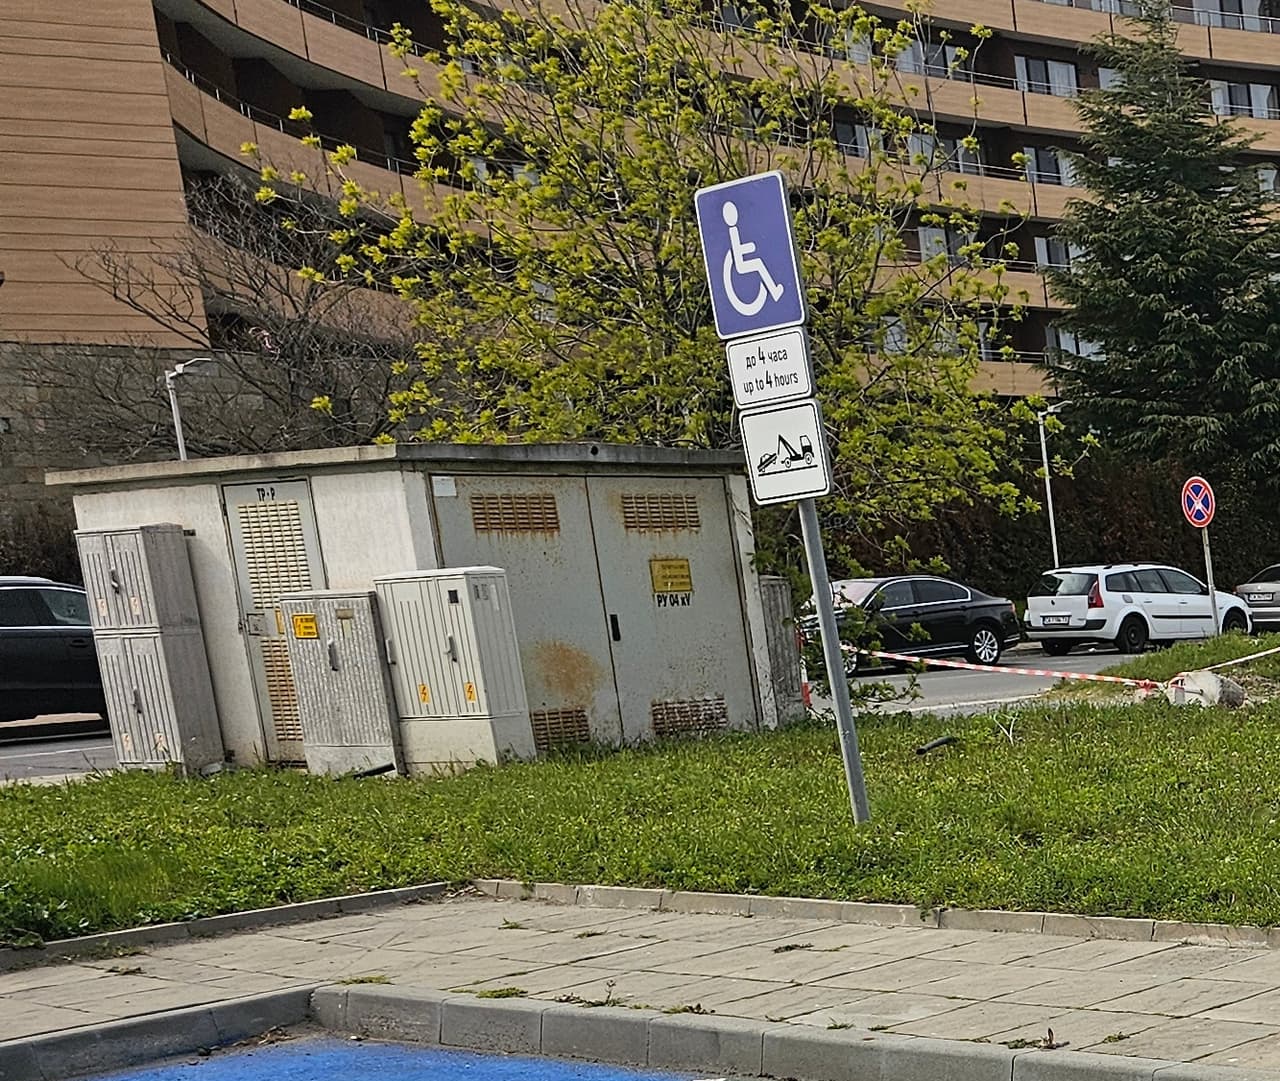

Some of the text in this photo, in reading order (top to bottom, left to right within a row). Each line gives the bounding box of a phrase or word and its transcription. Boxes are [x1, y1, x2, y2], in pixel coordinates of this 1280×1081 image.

[745, 346, 788, 370] до 4 часа
[743, 370, 799, 396] up to 4 hours
